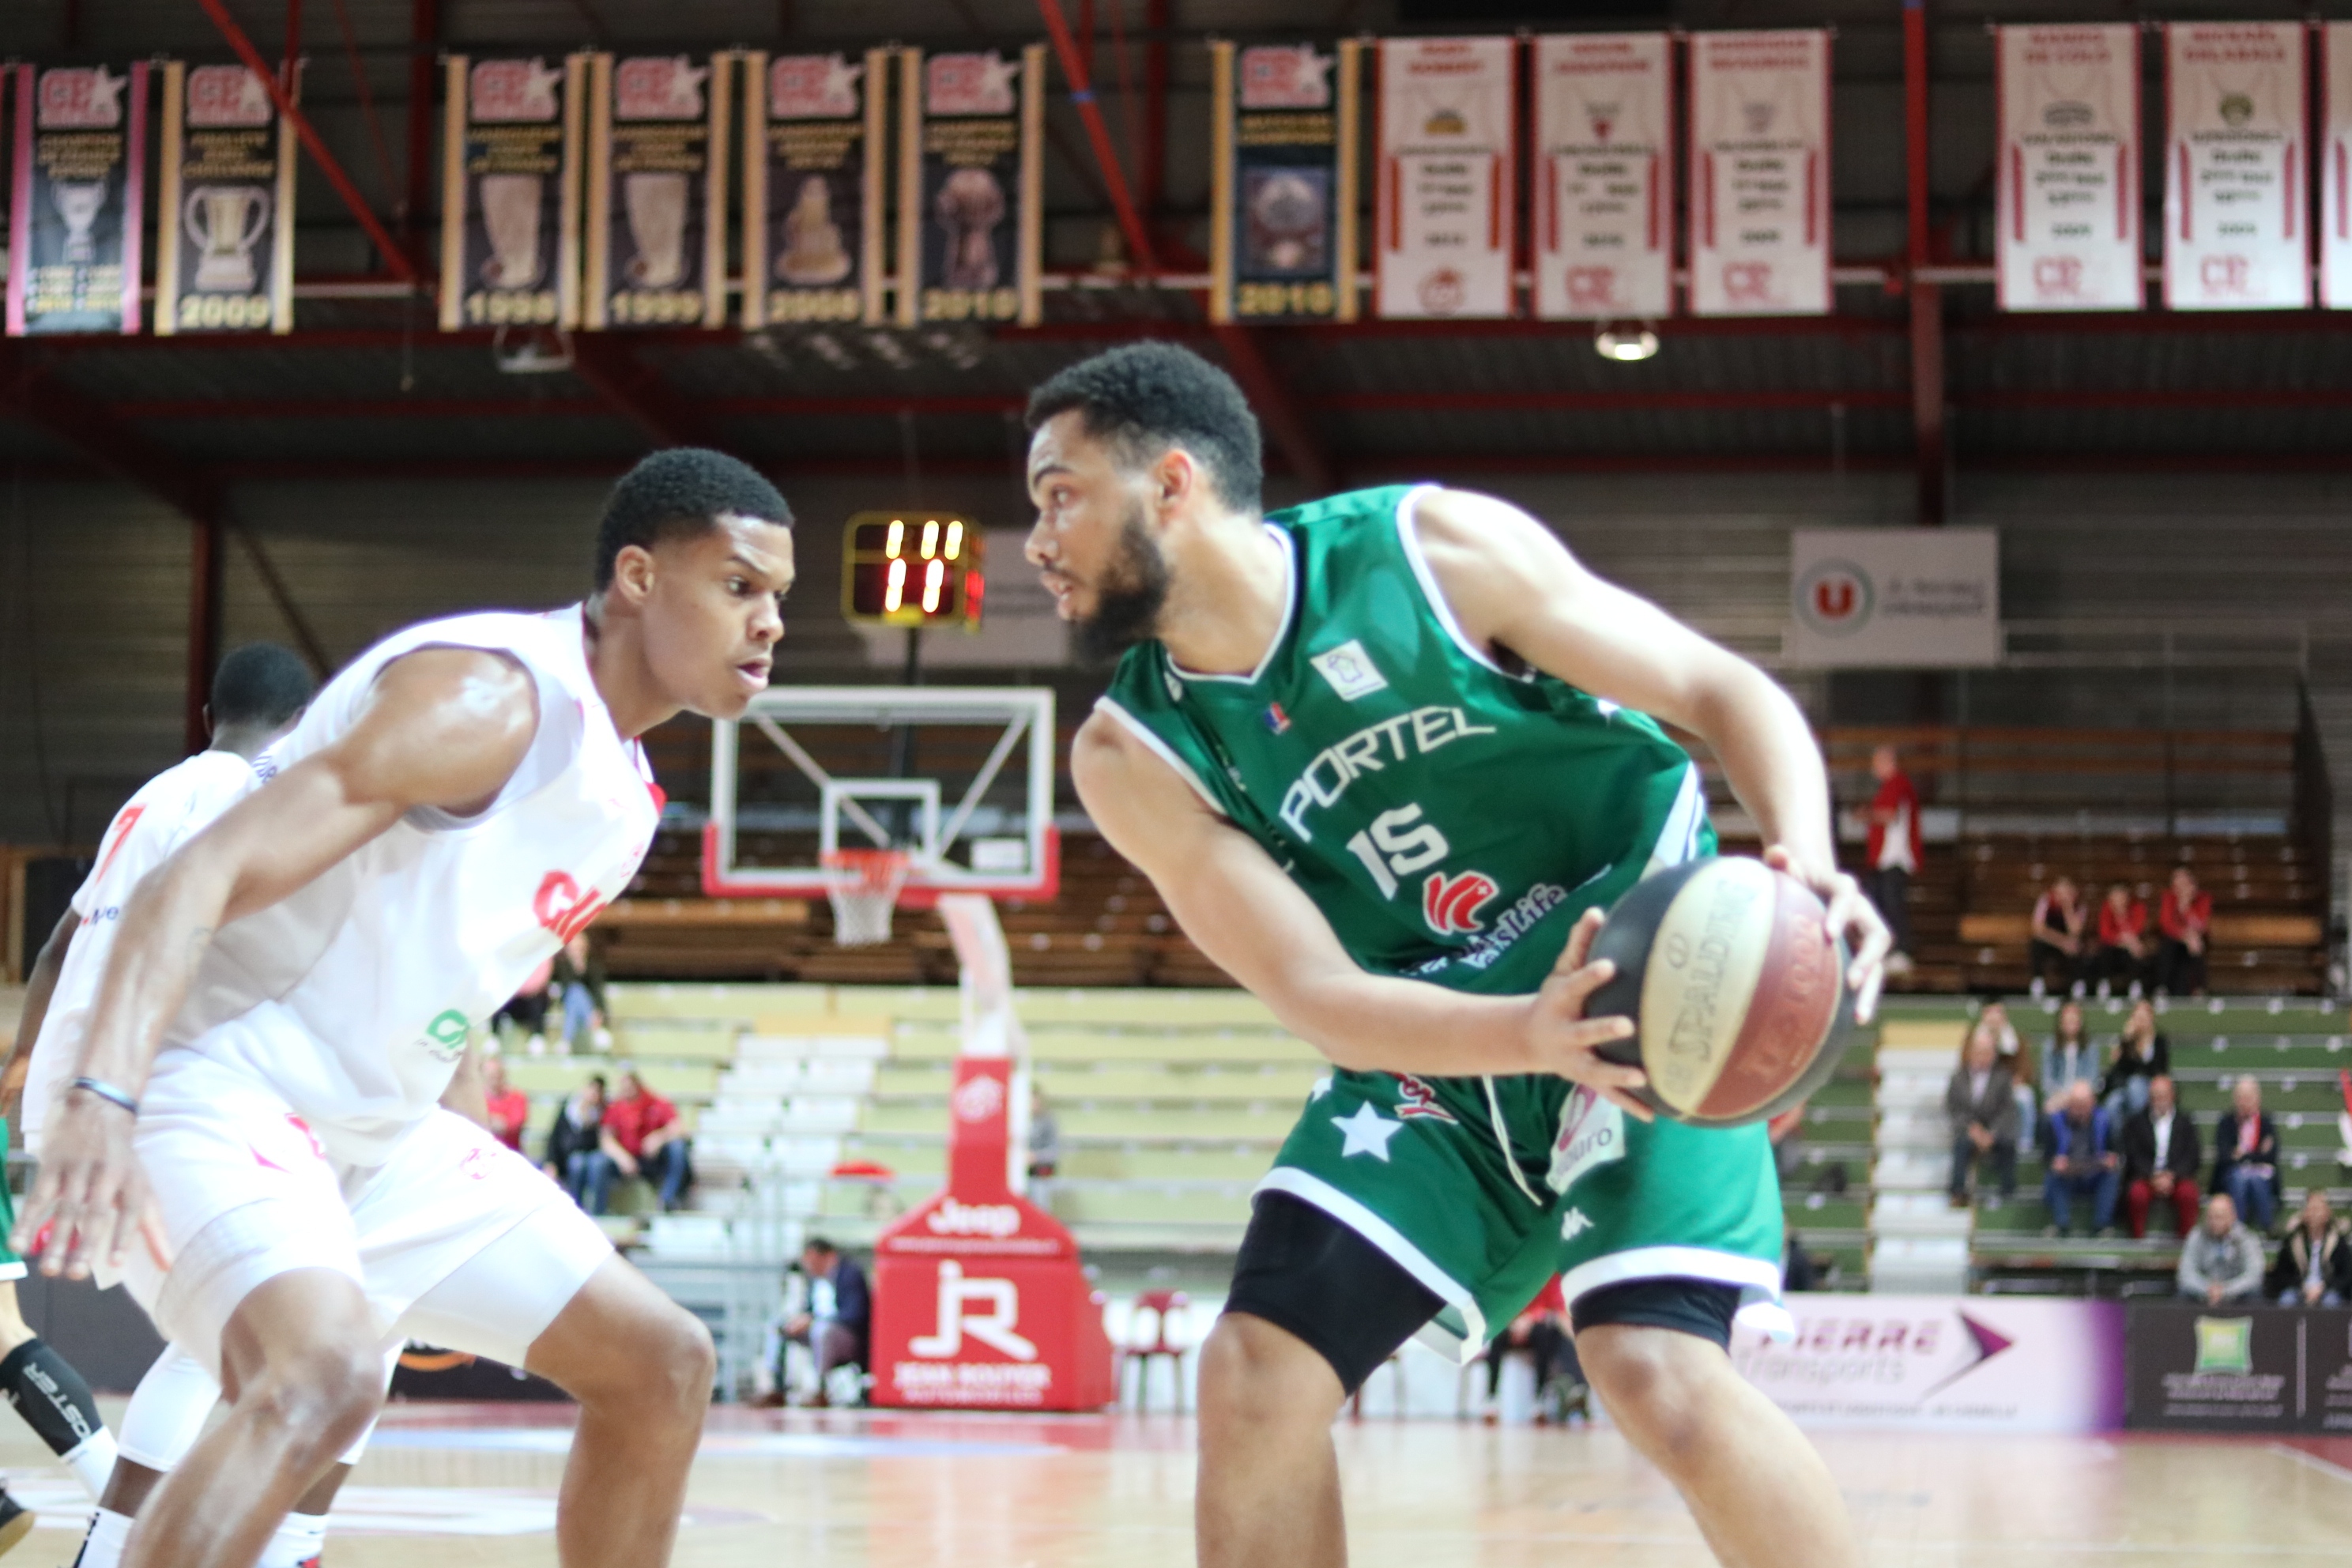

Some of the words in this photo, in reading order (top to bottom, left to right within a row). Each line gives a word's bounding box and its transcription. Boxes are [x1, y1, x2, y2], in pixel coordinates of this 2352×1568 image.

[179, 293, 270, 329] 2009
[1279, 705, 1497, 843] PORTEL
[1346, 801, 1449, 901] 15
[927, 1197, 1021, 1238] Jeep
